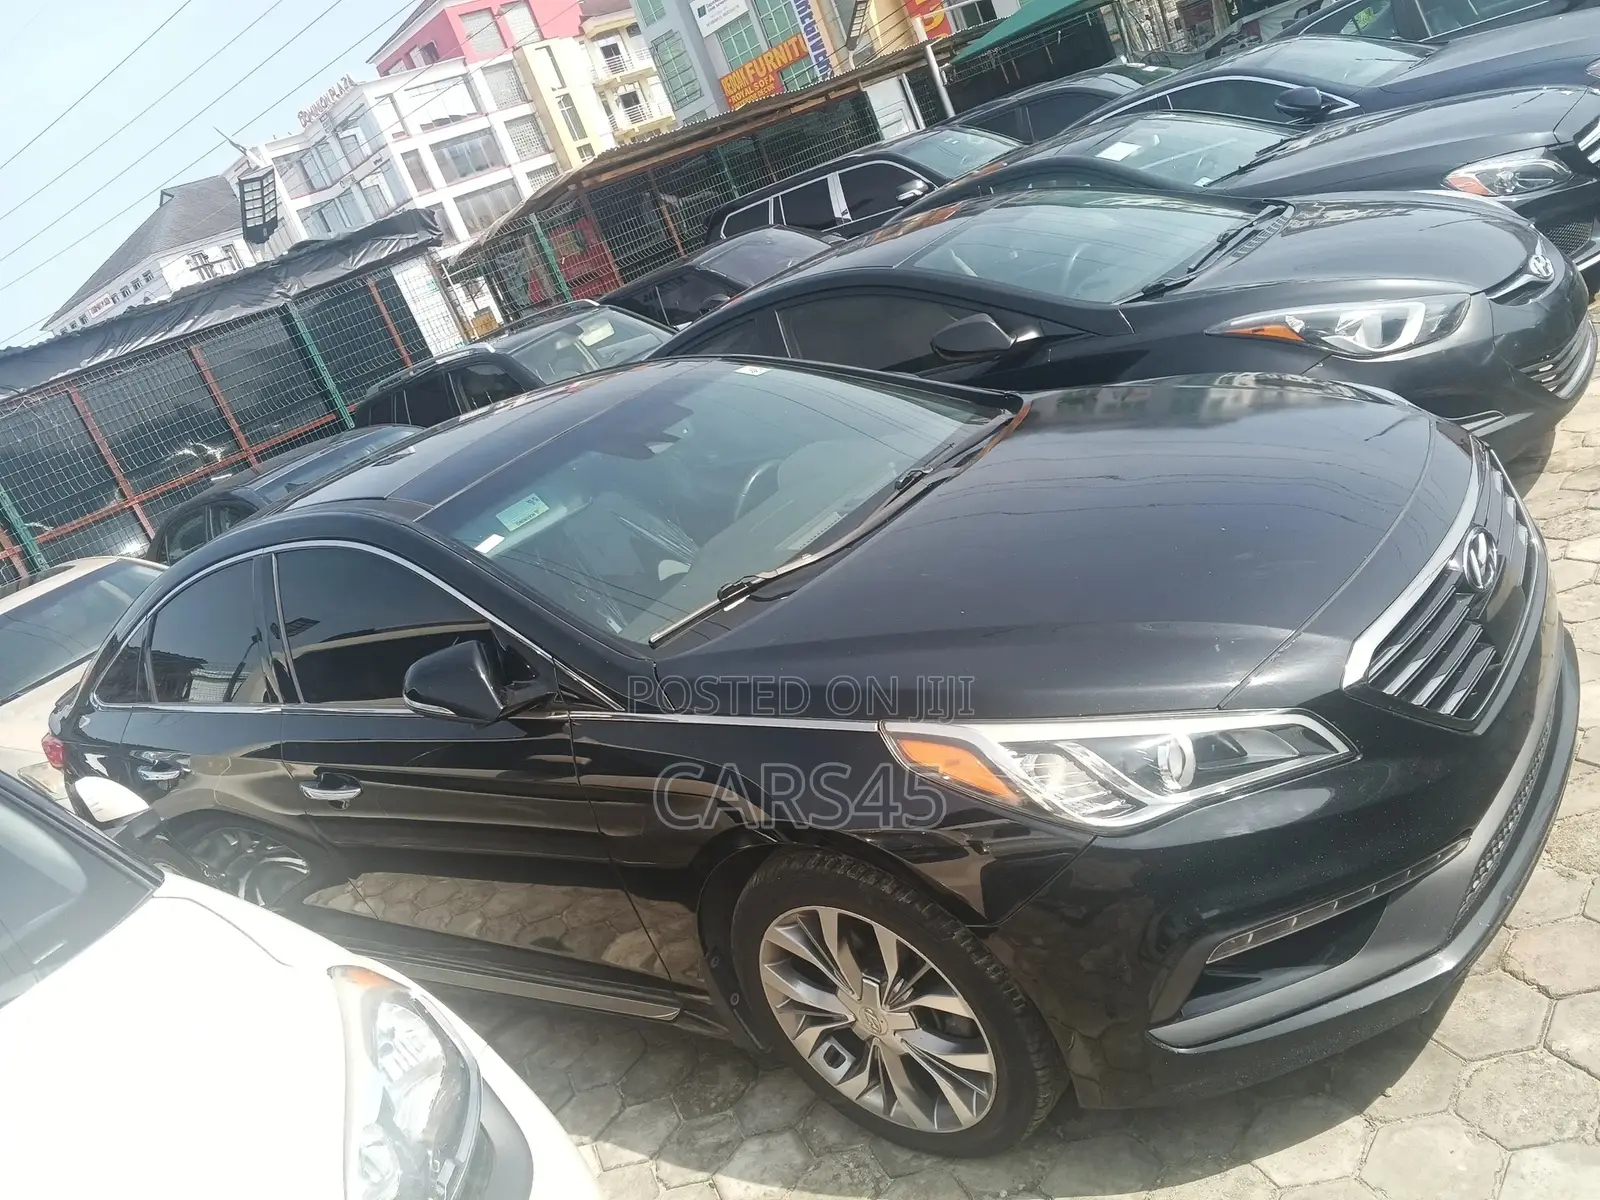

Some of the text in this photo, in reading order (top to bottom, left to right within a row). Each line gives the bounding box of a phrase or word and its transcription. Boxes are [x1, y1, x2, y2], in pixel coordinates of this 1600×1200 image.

[328, 73, 357, 104] PLAZA
[731, 87, 754, 104] ROYAL
[753, 74, 775, 90] SOFA
